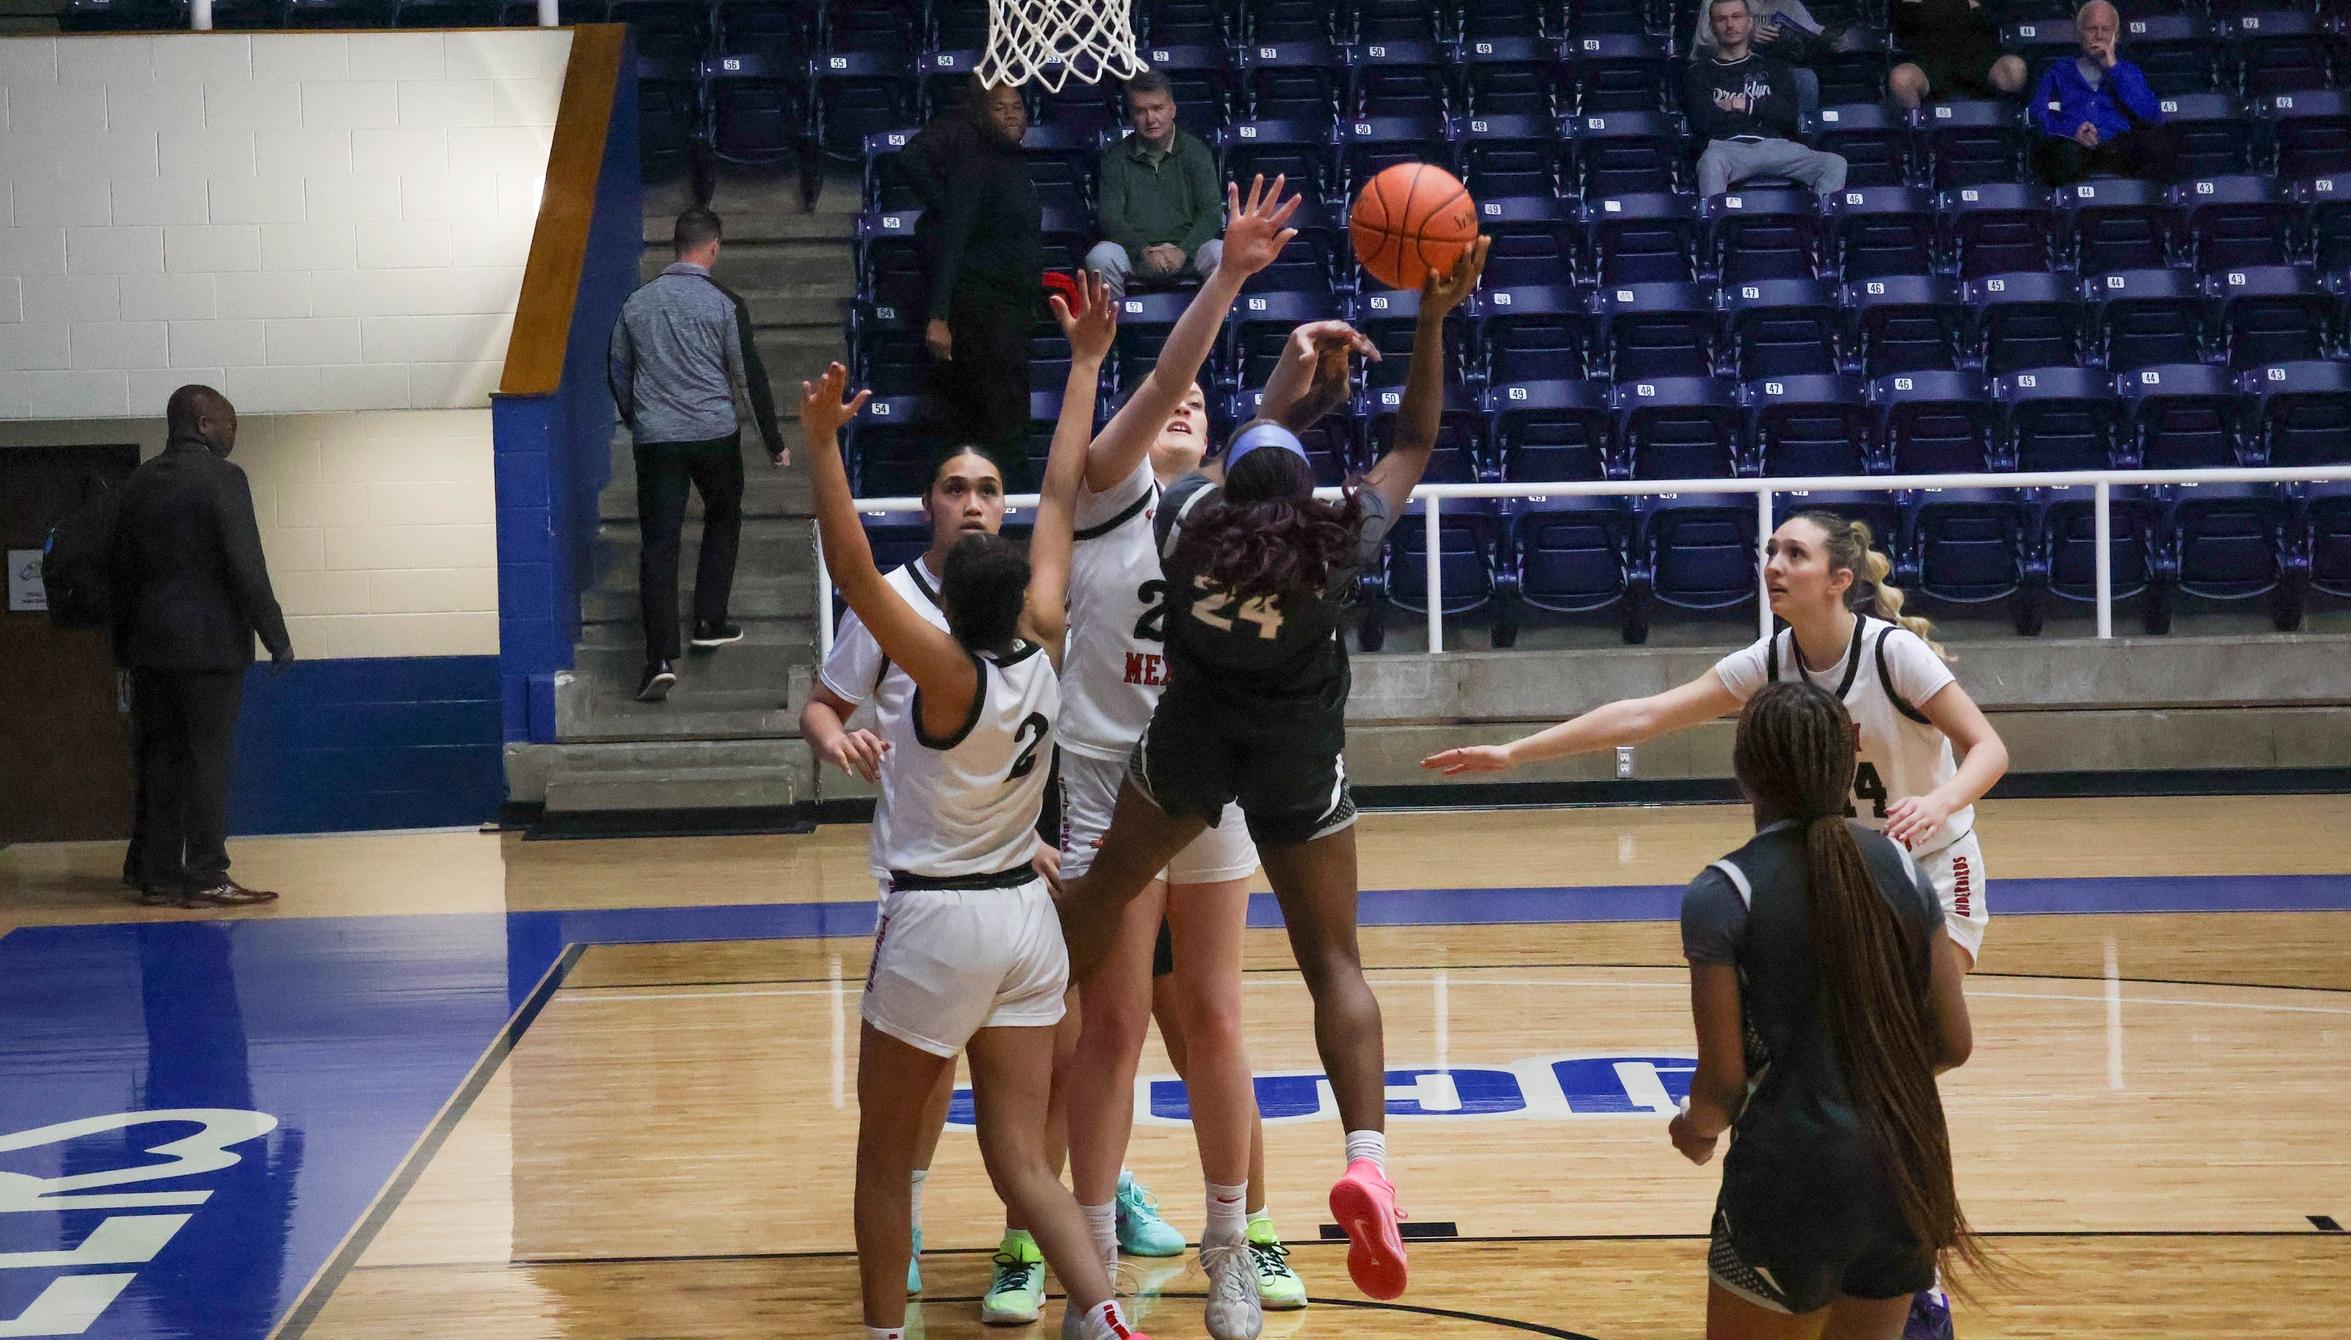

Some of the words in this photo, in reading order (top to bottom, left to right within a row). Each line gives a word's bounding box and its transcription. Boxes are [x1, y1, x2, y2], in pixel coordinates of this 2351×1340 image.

[2132, 22, 2142, 32] 43
[2245, 18, 2255, 28] 42
[1479, 43, 1489, 53] 49
[1586, 40, 1596, 50] 48
[1155, 51, 1166, 61] 52
[1263, 48, 1273, 58] 51
[1372, 47, 1382, 57] 50
[726, 60, 737, 70] 56
[833, 58, 844, 68] 55
[940, 56, 950, 66] 54
[2163, 101, 2174, 112] 43
[2278, 97, 2289, 108] 42
[1357, 124, 1368, 134] 50
[1474, 121, 1484, 131] 49
[1591, 119, 1601, 129] 48
[1242, 127, 1253, 137] 51
[891, 135, 902, 145] 54
[2199, 183, 2211, 194] 43
[2318, 180, 2330, 191] 42
[2080, 186, 2091, 197] 44
[1849, 194, 1860, 204] 46
[1487, 204, 1498, 214] 49
[887, 217, 898, 228] 54
[2109, 277, 2121, 288] 44
[2231, 273, 2242, 285] 43
[1869, 283, 1881, 294] 46
[1990, 280, 2001, 291] 45
[1744, 287, 1756, 298] 47
[1128, 302, 1140, 313] 52
[1253, 299, 1264, 310] 51
[1373, 298, 1385, 308] 50
[2144, 372, 2156, 384] 44
[2270, 369, 2283, 380] 43
[1897, 378, 1909, 390] 46
[2022, 375, 2032, 387] 45
[1511, 388, 1524, 400] 49
[1639, 384, 1652, 396] 48
[1768, 383, 1780, 394] 47
[1384, 393, 1397, 404] 50
[874, 403, 886, 414] 54
[1133, 579, 1167, 642] 2
[1191, 575, 1284, 640] 24
[1002, 711, 1049, 784] 2
